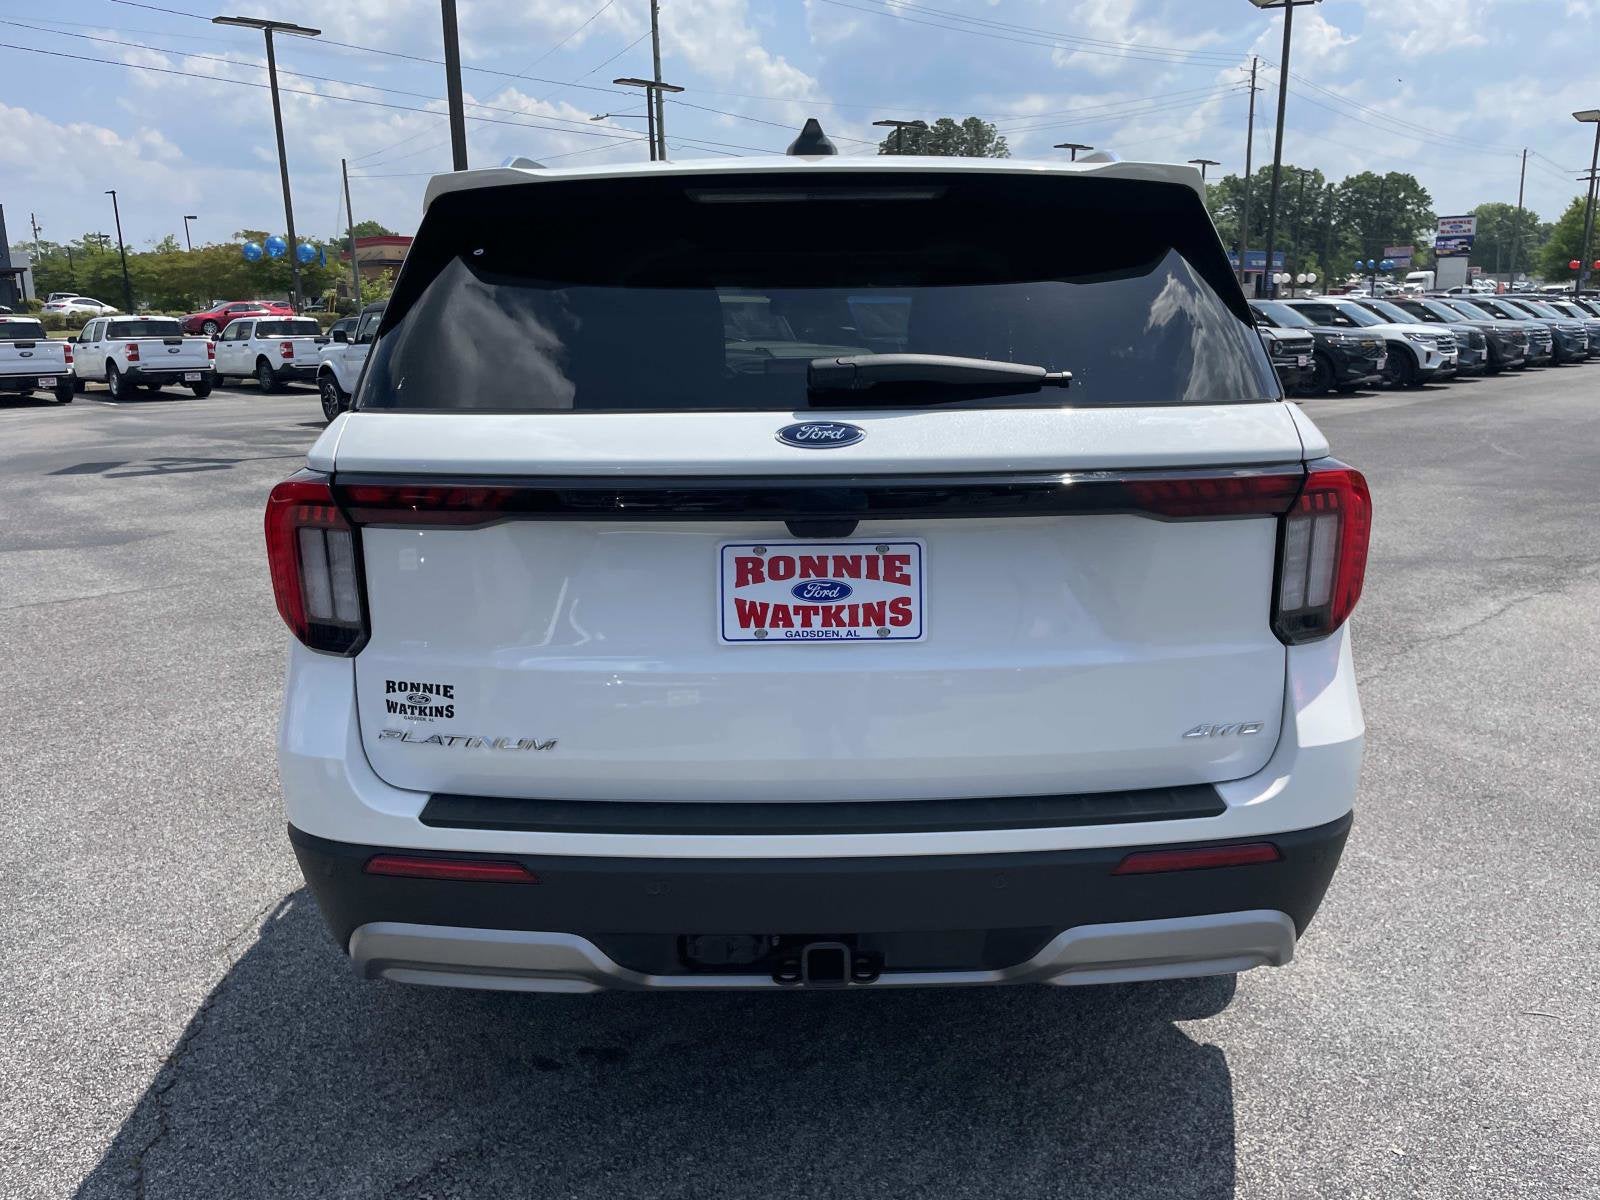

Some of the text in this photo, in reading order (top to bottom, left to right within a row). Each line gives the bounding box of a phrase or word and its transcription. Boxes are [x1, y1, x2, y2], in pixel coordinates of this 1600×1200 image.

[796, 423, 845, 440] Ford
[735, 555, 911, 588] RONNIE
[803, 583, 839, 598] Ford
[734, 596, 912, 628] WATKINS
[846, 629, 861, 637] AL
[385, 680, 454, 699] RONNIE
[385, 699, 455, 719] WATKINS
[378, 729, 560, 751] PLATINUM
